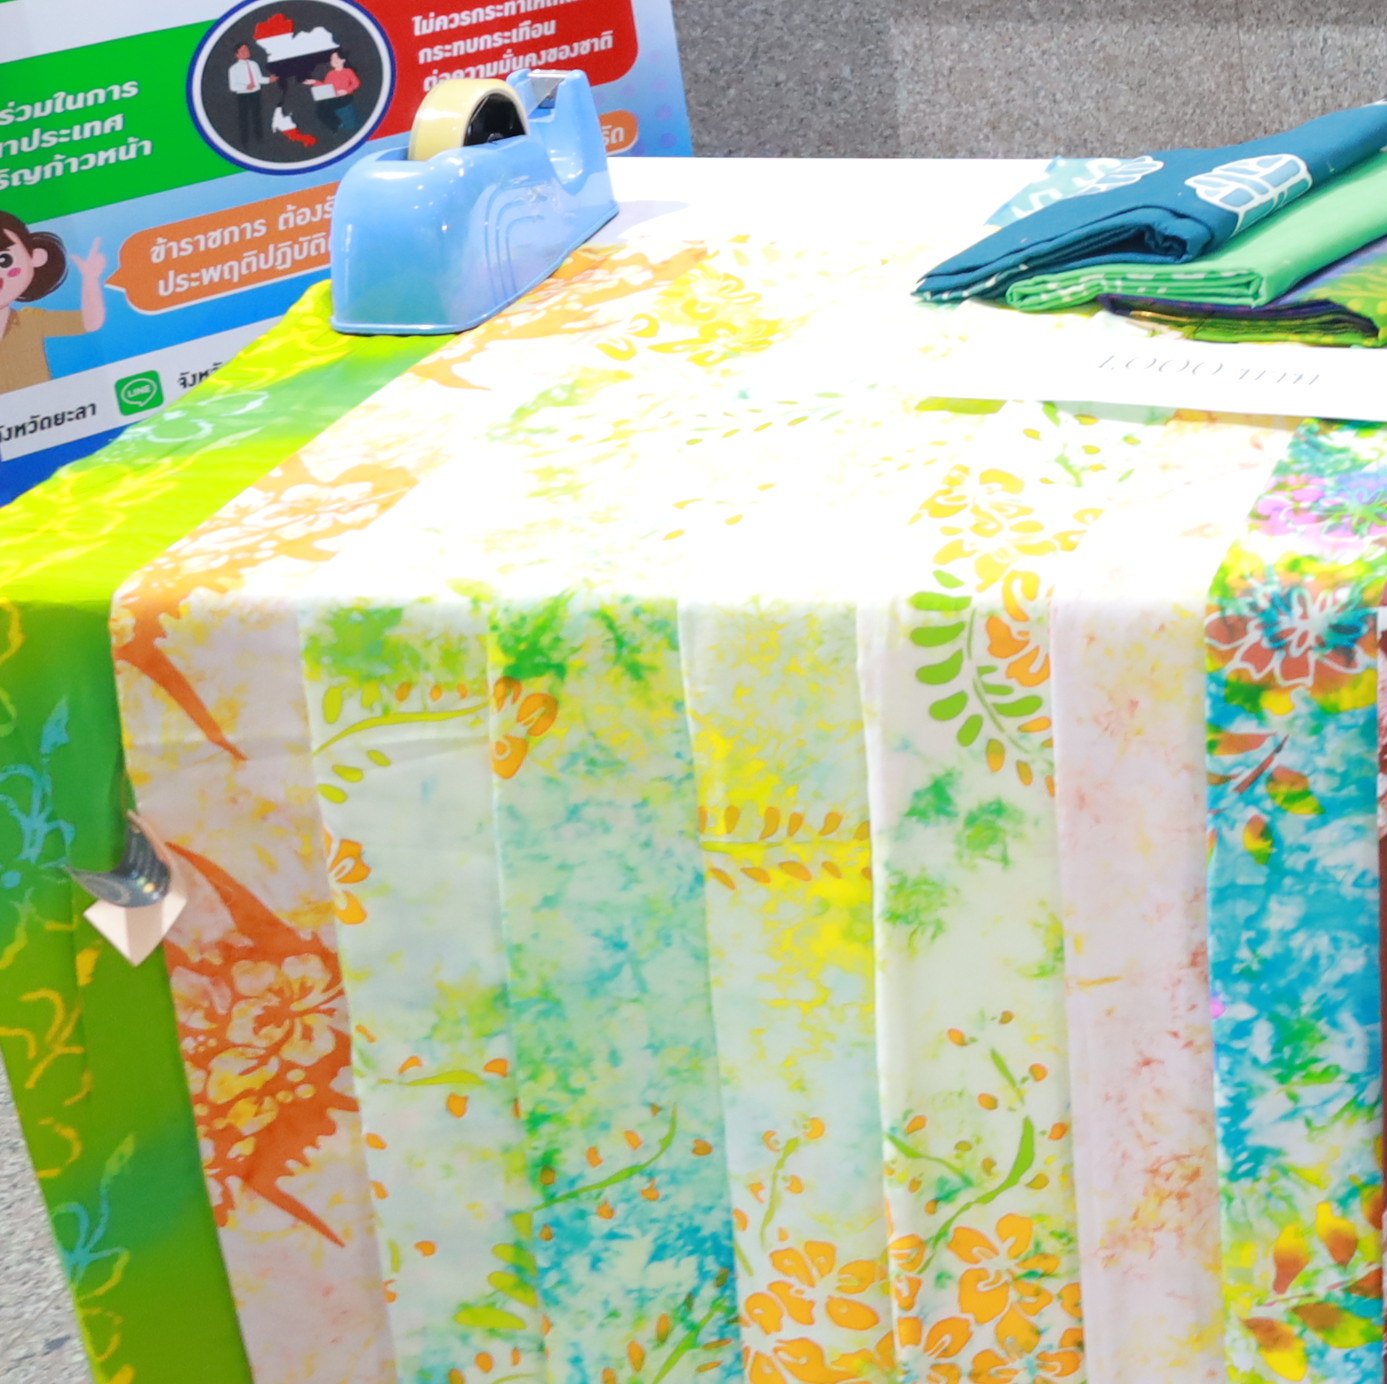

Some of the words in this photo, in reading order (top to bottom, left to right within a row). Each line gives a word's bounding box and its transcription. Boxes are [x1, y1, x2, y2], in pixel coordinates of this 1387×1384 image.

[418, 20, 556, 64] กระทบกระเทือน
[0, 113, 124, 158] าประเทศ
[149, 218, 268, 264] ข้าราชการ
[157, 232, 331, 297] ประพฤติปฏิบัติ
[127, 384, 151, 398] LINE
